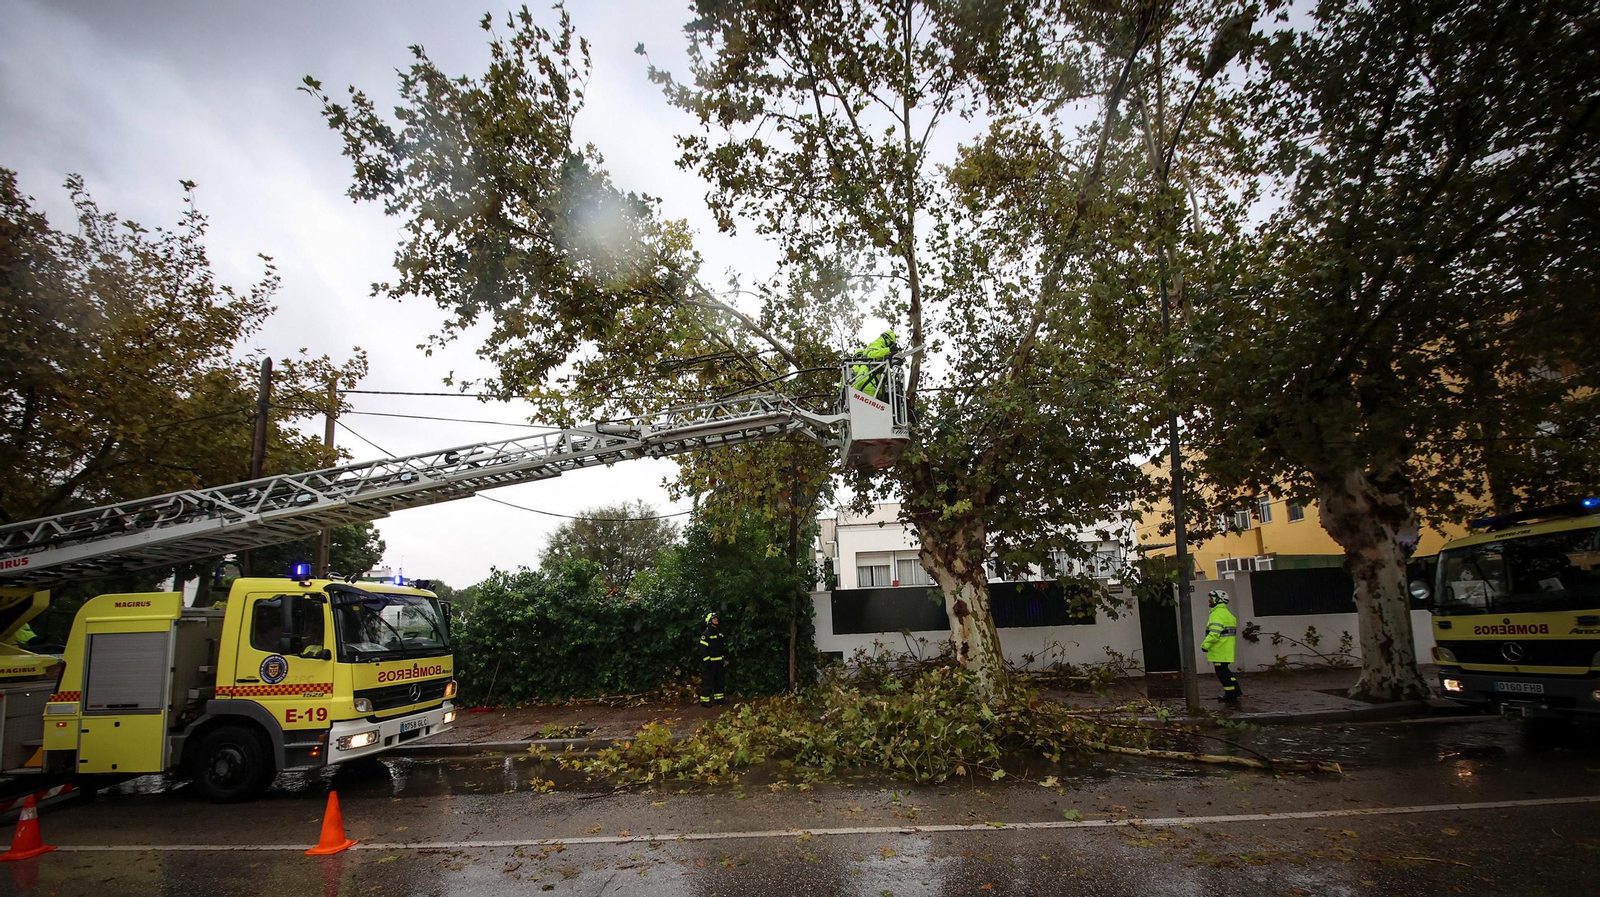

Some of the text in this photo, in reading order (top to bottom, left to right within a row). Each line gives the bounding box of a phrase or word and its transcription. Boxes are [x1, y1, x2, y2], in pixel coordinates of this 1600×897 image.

[853, 393, 886, 411] MAGIRUS
[114, 600, 151, 608] MAGIRUS
[1499, 682, 1542, 692] 0160 FHB
[286, 707, 328, 723] E-19
